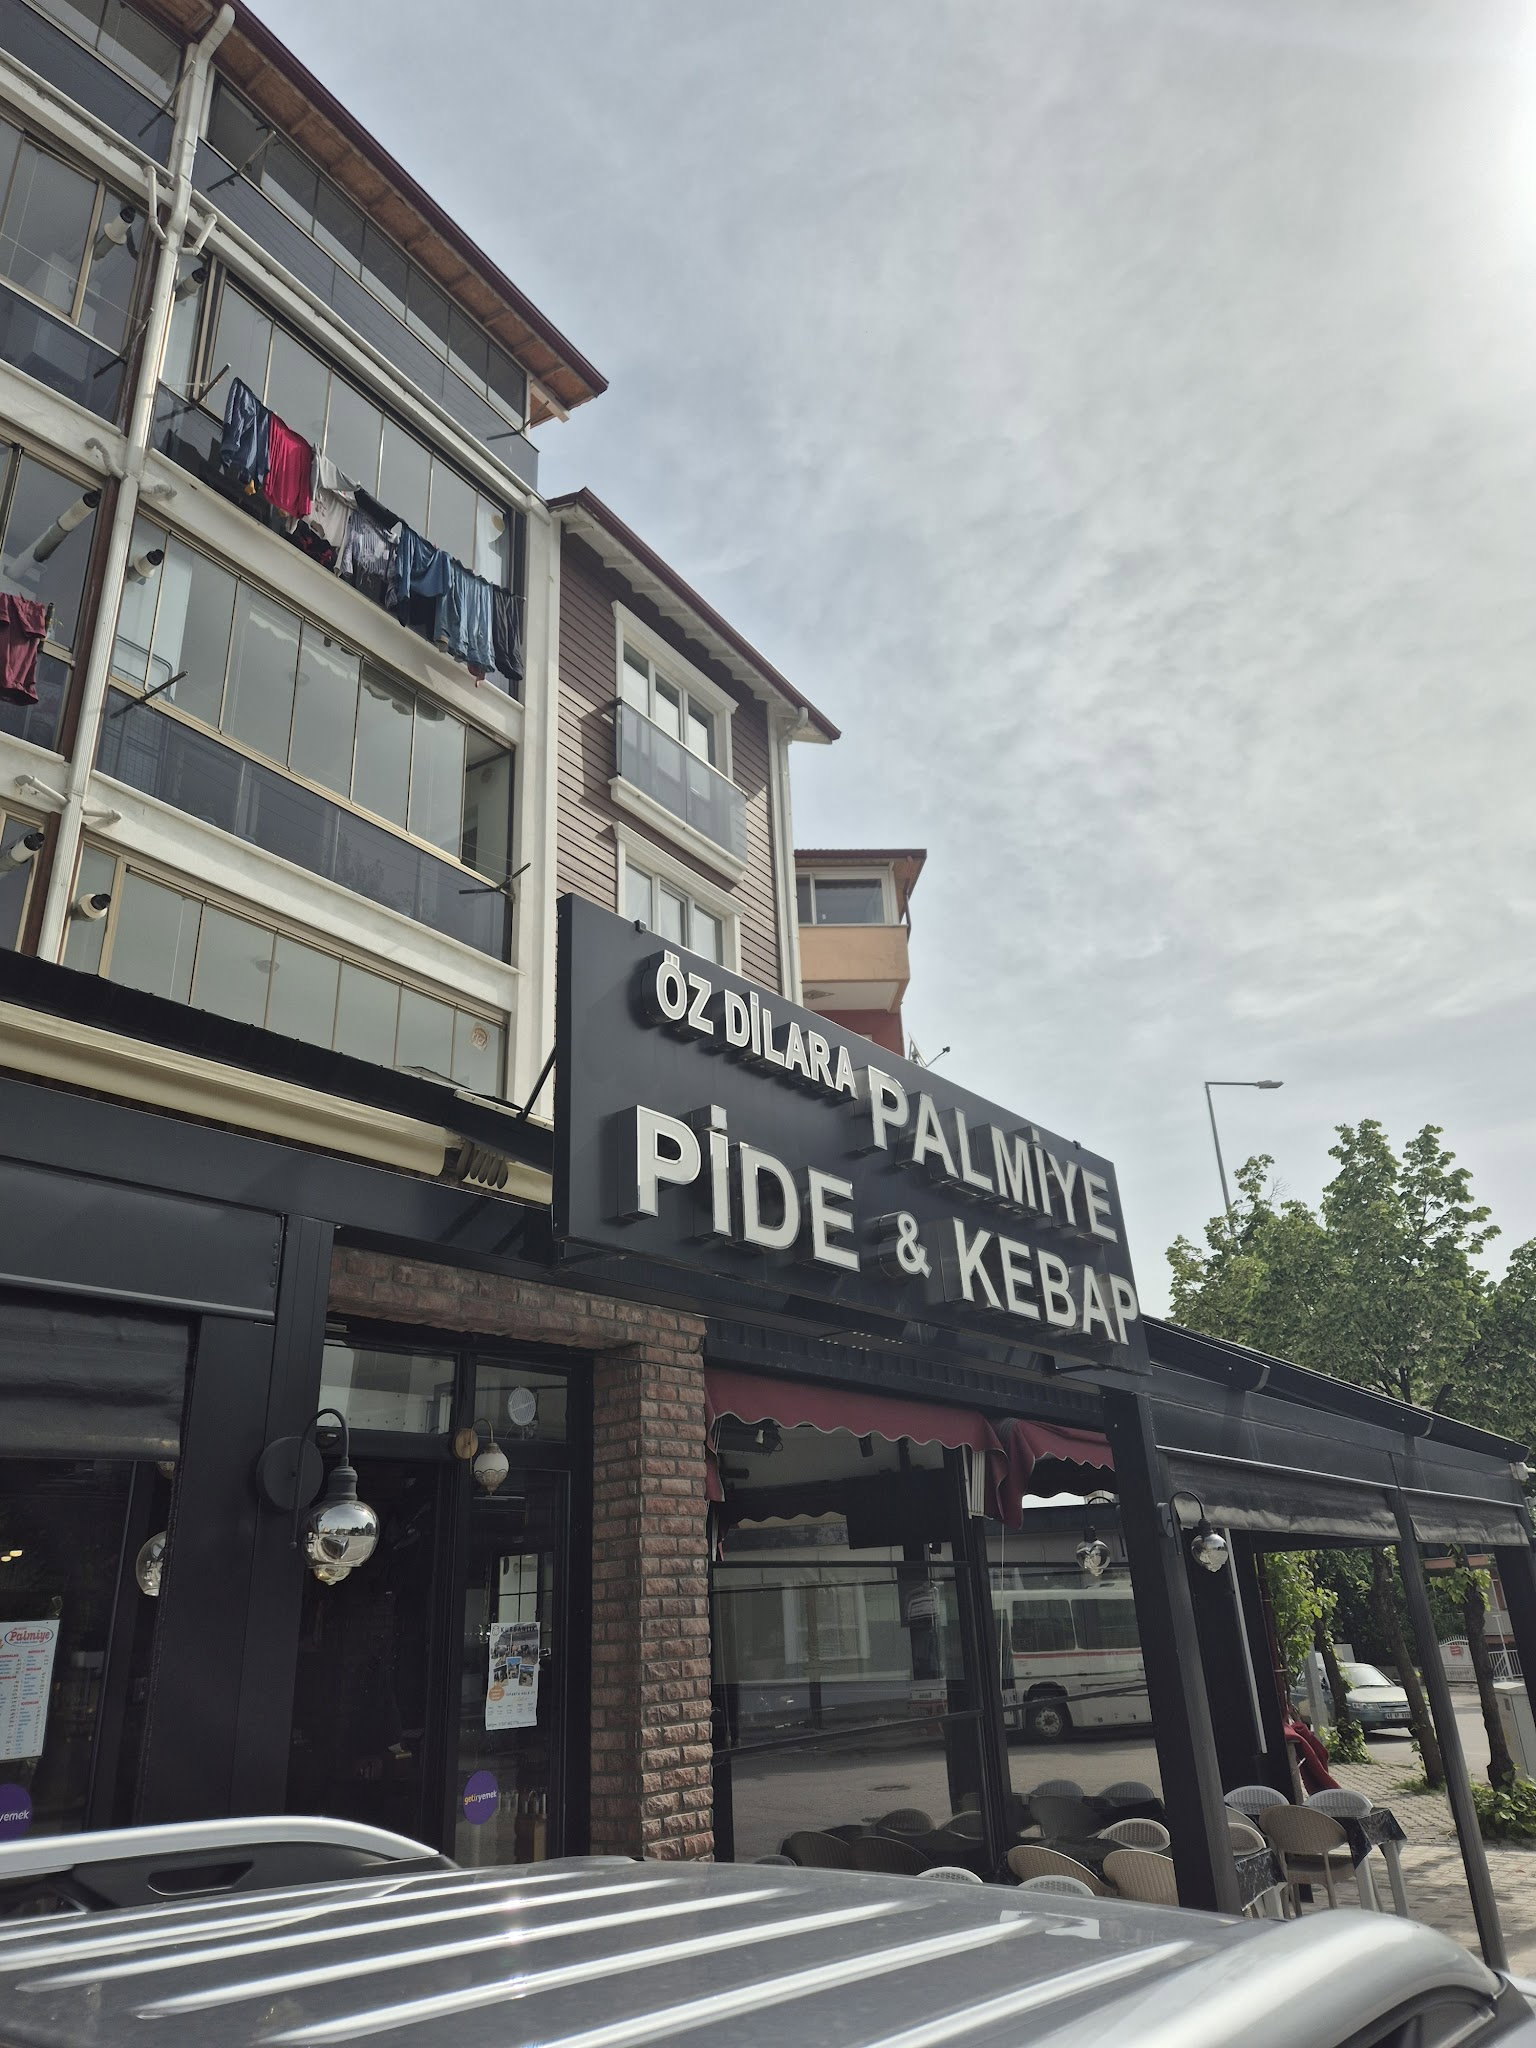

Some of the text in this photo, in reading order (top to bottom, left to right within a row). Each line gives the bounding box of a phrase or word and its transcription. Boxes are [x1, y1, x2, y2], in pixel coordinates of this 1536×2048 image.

[637, 1104, 1139, 1346] PİDE & KEBAP
[656, 950, 1118, 1243] ÖZ DİLARA PALMİYE
